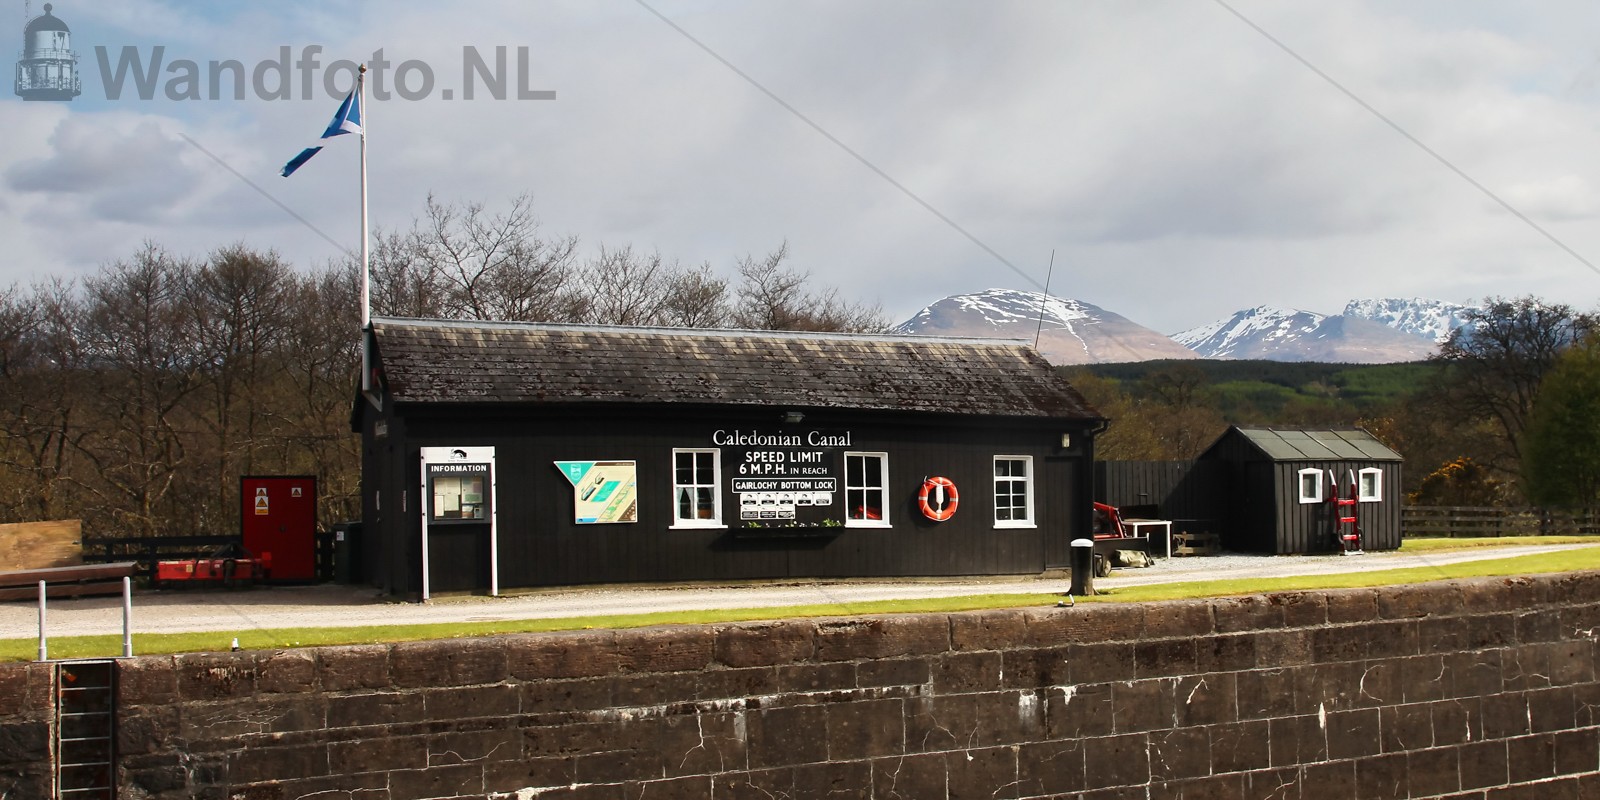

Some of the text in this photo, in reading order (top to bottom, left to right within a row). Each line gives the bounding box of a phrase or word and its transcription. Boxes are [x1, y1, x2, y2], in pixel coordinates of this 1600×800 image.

[713, 430, 852, 446] Caledonian Canal
[745, 451, 823, 462] SPEED LIMIT
[739, 463, 828, 475] 6 M.P.H. IN REACH
[735, 481, 833, 490] GAIRLOCHY BOTTOM LOCK
